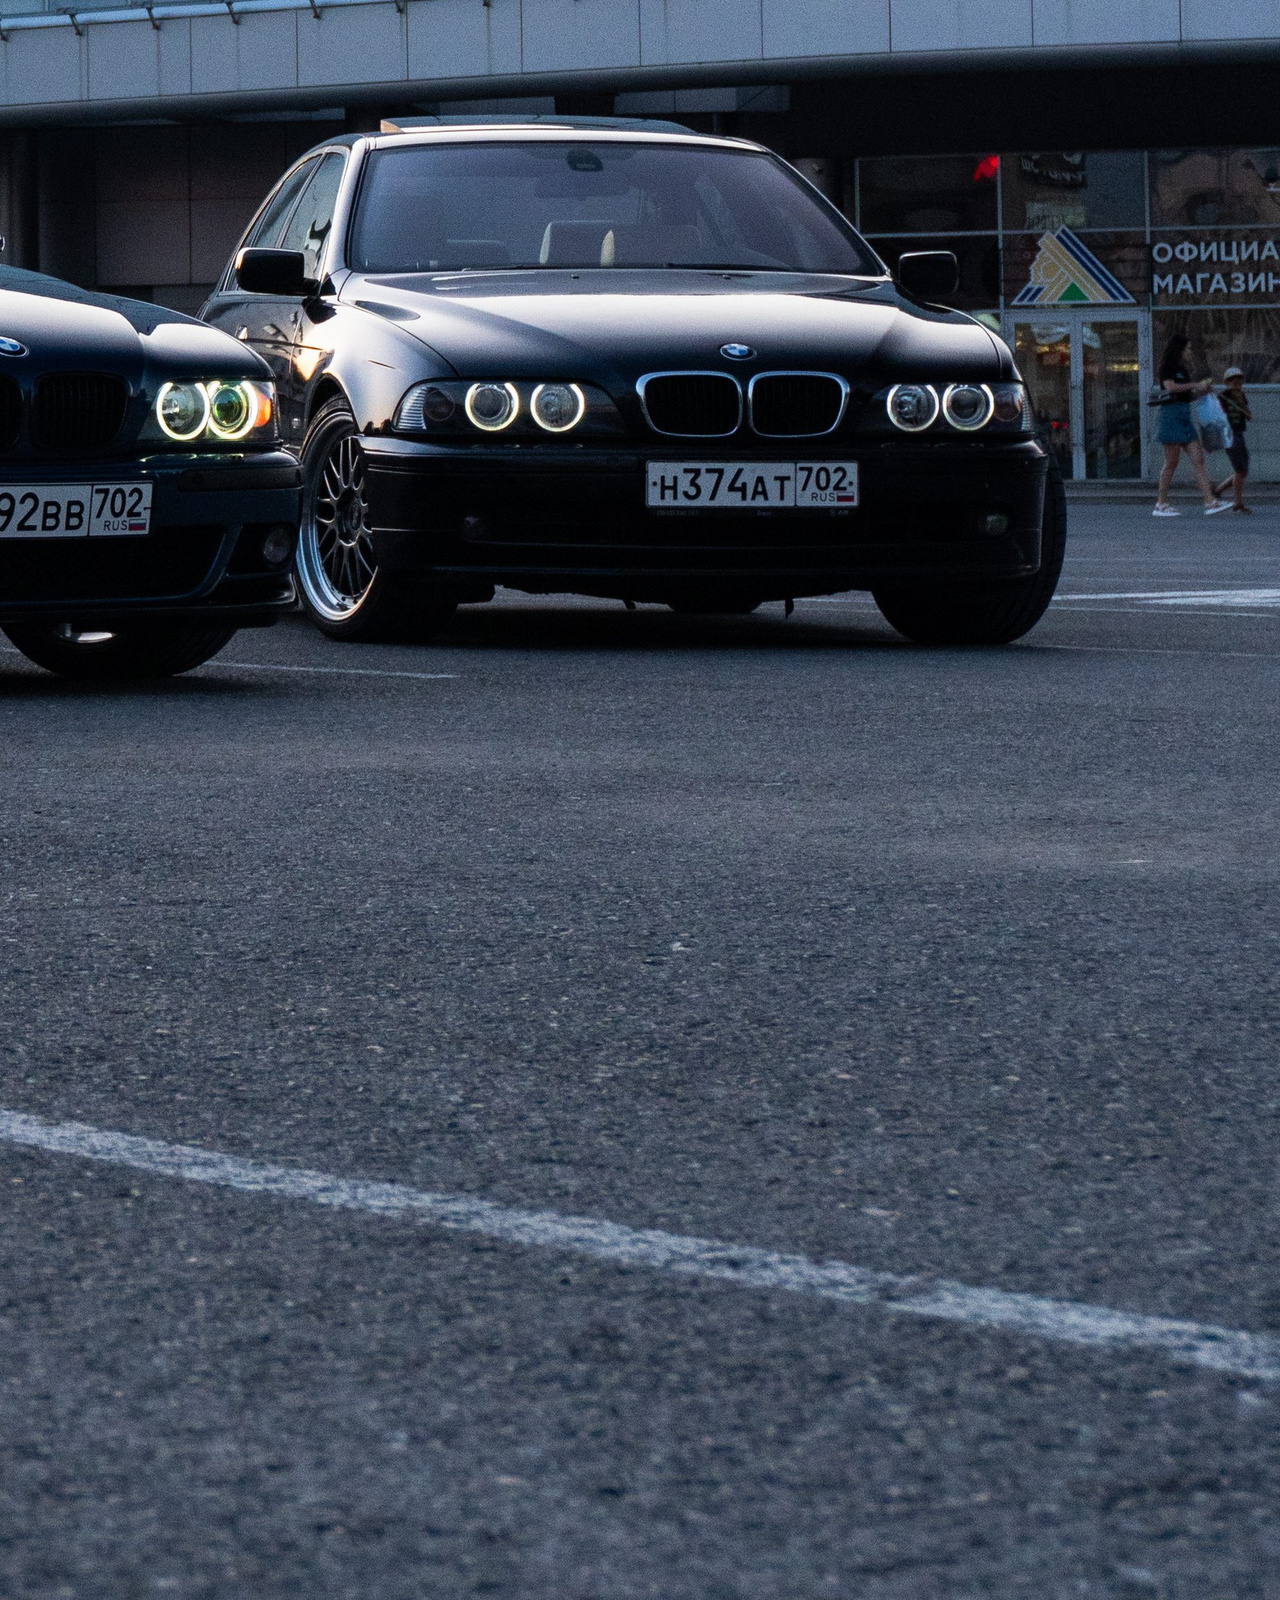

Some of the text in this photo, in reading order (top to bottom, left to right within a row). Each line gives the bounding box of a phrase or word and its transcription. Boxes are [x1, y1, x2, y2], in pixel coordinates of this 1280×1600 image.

[1152, 240, 1279, 265] ОФИЦИА
[659, 466, 847, 501] Н374АТ 702
[94, 487, 143, 519] 702
[811, 492, 836, 502] RUS
[103, 520, 128, 532] RUS
